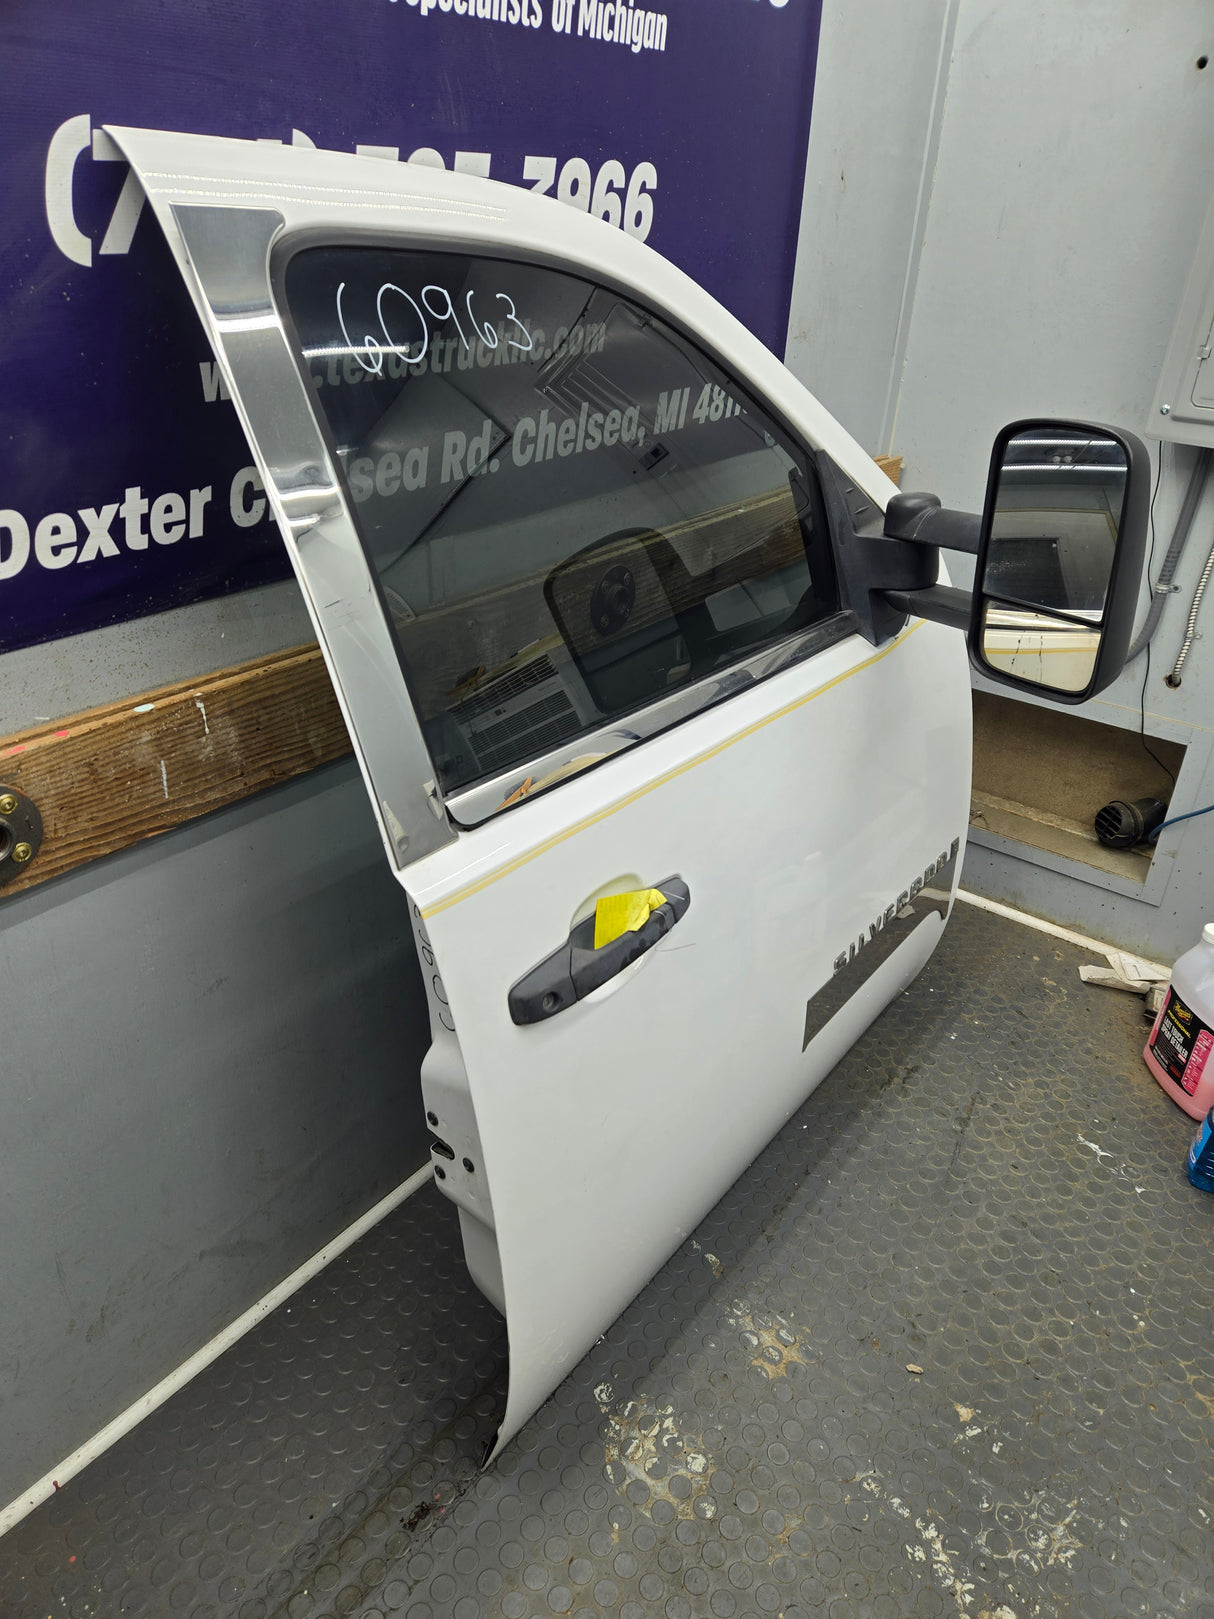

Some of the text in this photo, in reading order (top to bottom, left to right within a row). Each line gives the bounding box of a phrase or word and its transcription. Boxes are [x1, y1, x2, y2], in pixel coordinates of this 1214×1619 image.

[578, 0, 668, 54] Michigan
[337, 283, 533, 377] 60963
[0, 485, 212, 580] Dexter
[441, 418, 500, 484] Rd.
[512, 402, 646, 467] Chelsea,
[653, 387, 691, 434] MI
[692, 382, 748, 425] 481
